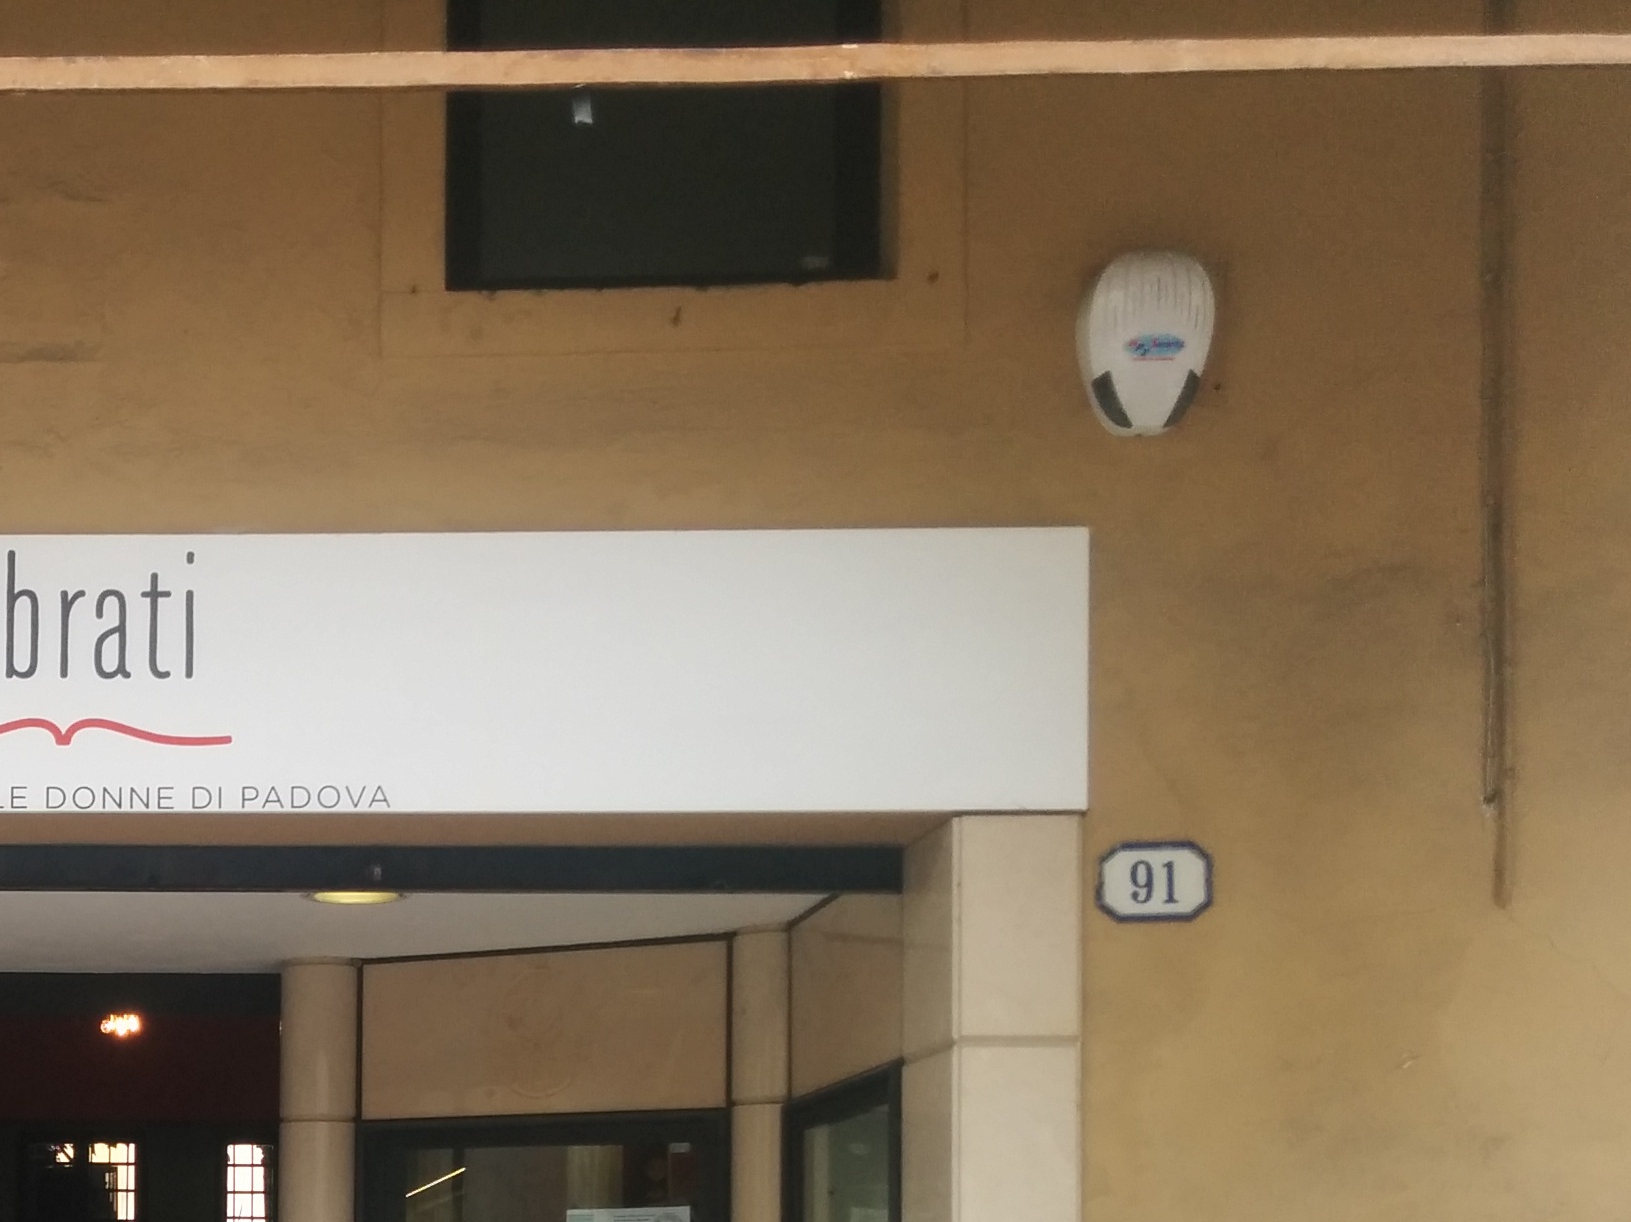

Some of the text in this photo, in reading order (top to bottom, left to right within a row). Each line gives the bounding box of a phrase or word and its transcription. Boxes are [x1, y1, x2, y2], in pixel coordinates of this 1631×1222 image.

[45, 785, 175, 811] DONNE
[192, 786, 223, 810] DI
[241, 785, 392, 810] PADOVA
[1129, 859, 1180, 904] 91
